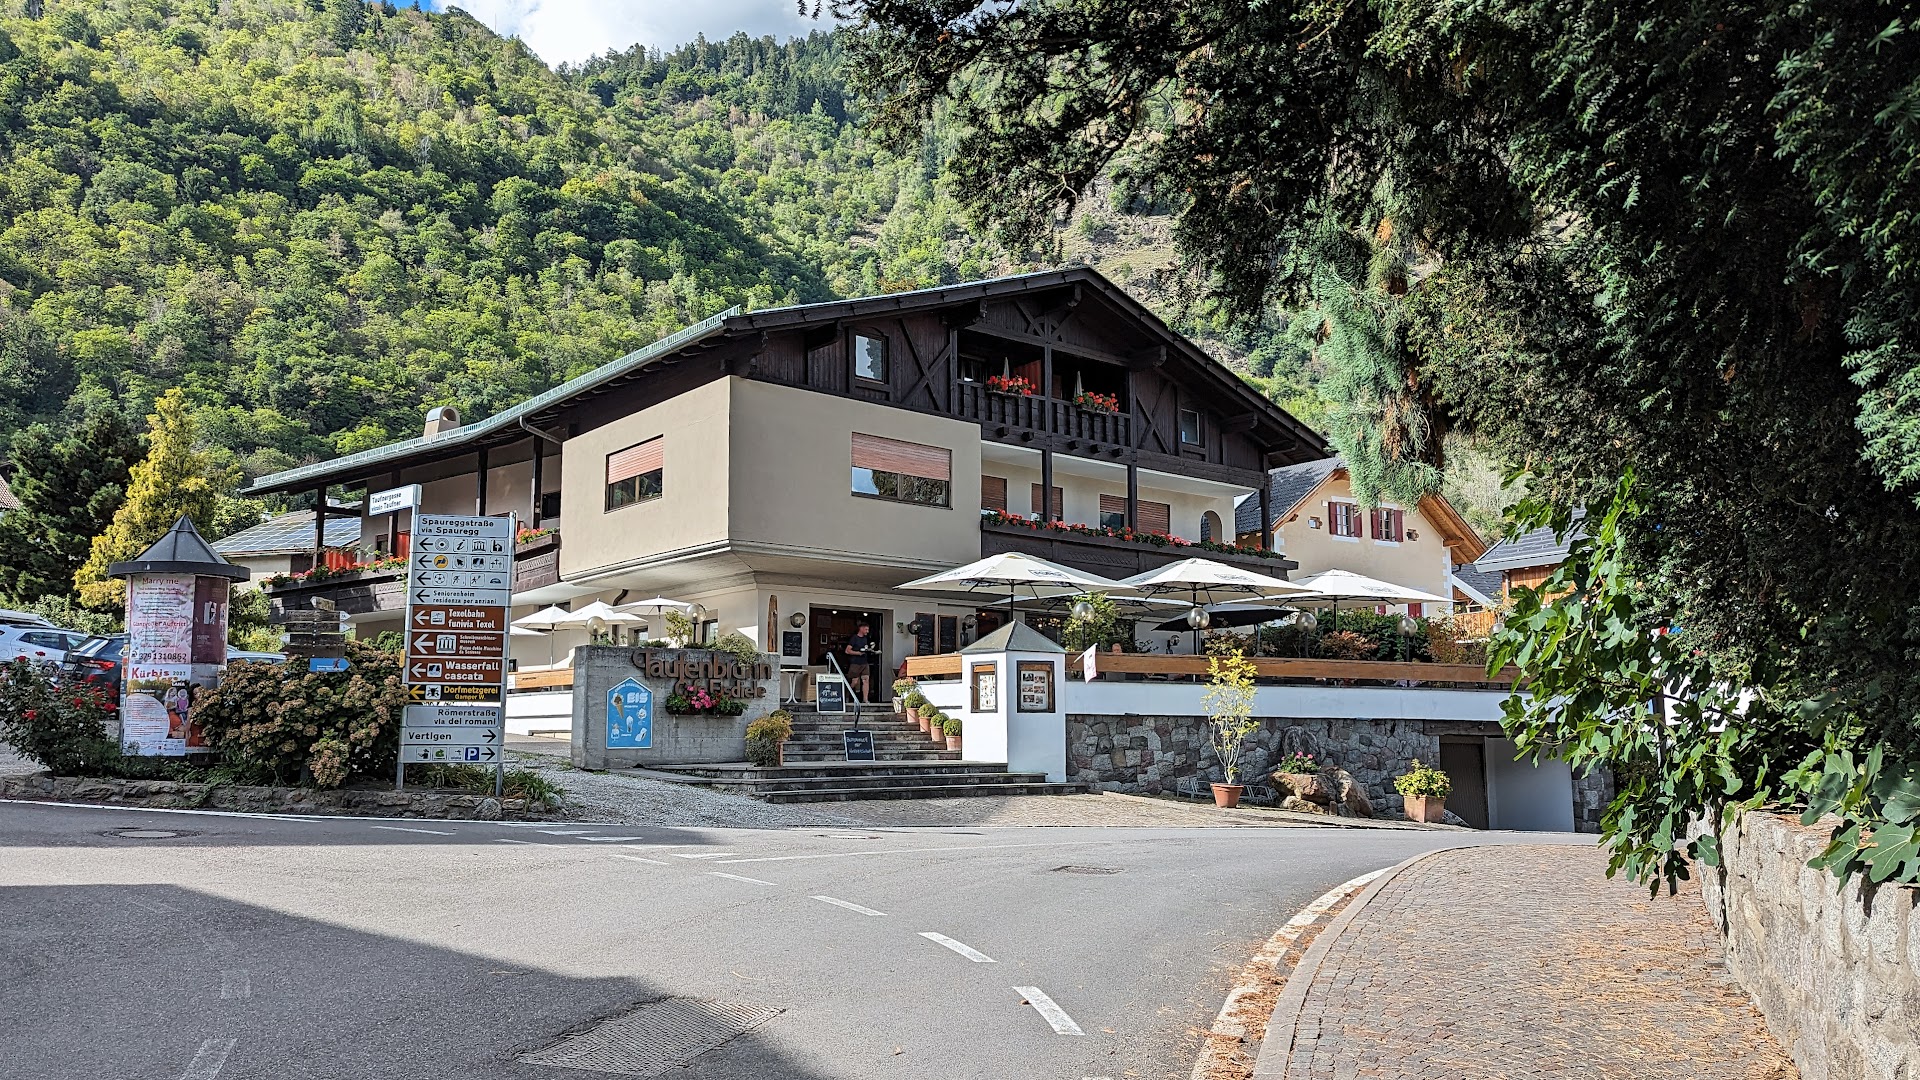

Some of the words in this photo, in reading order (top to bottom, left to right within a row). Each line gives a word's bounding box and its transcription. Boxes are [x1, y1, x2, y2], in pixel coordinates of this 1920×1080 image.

[421, 518, 494, 528] Spaureggstraße
[435, 527, 479, 536] Spauregg
[448, 608, 485, 618] Texelbahn
[448, 619, 474, 628] funivia
[476, 620, 495, 629] Texel
[445, 661, 499, 671] Wasserfall
[131, 667, 170, 680] Kürbis
[444, 672, 484, 681] cascata
[443, 686, 498, 695] Dorfmetzgerei
[627, 692, 649, 704] EIS
[438, 709, 497, 717] Römerstraße
[408, 732, 452, 741] Vertigen
